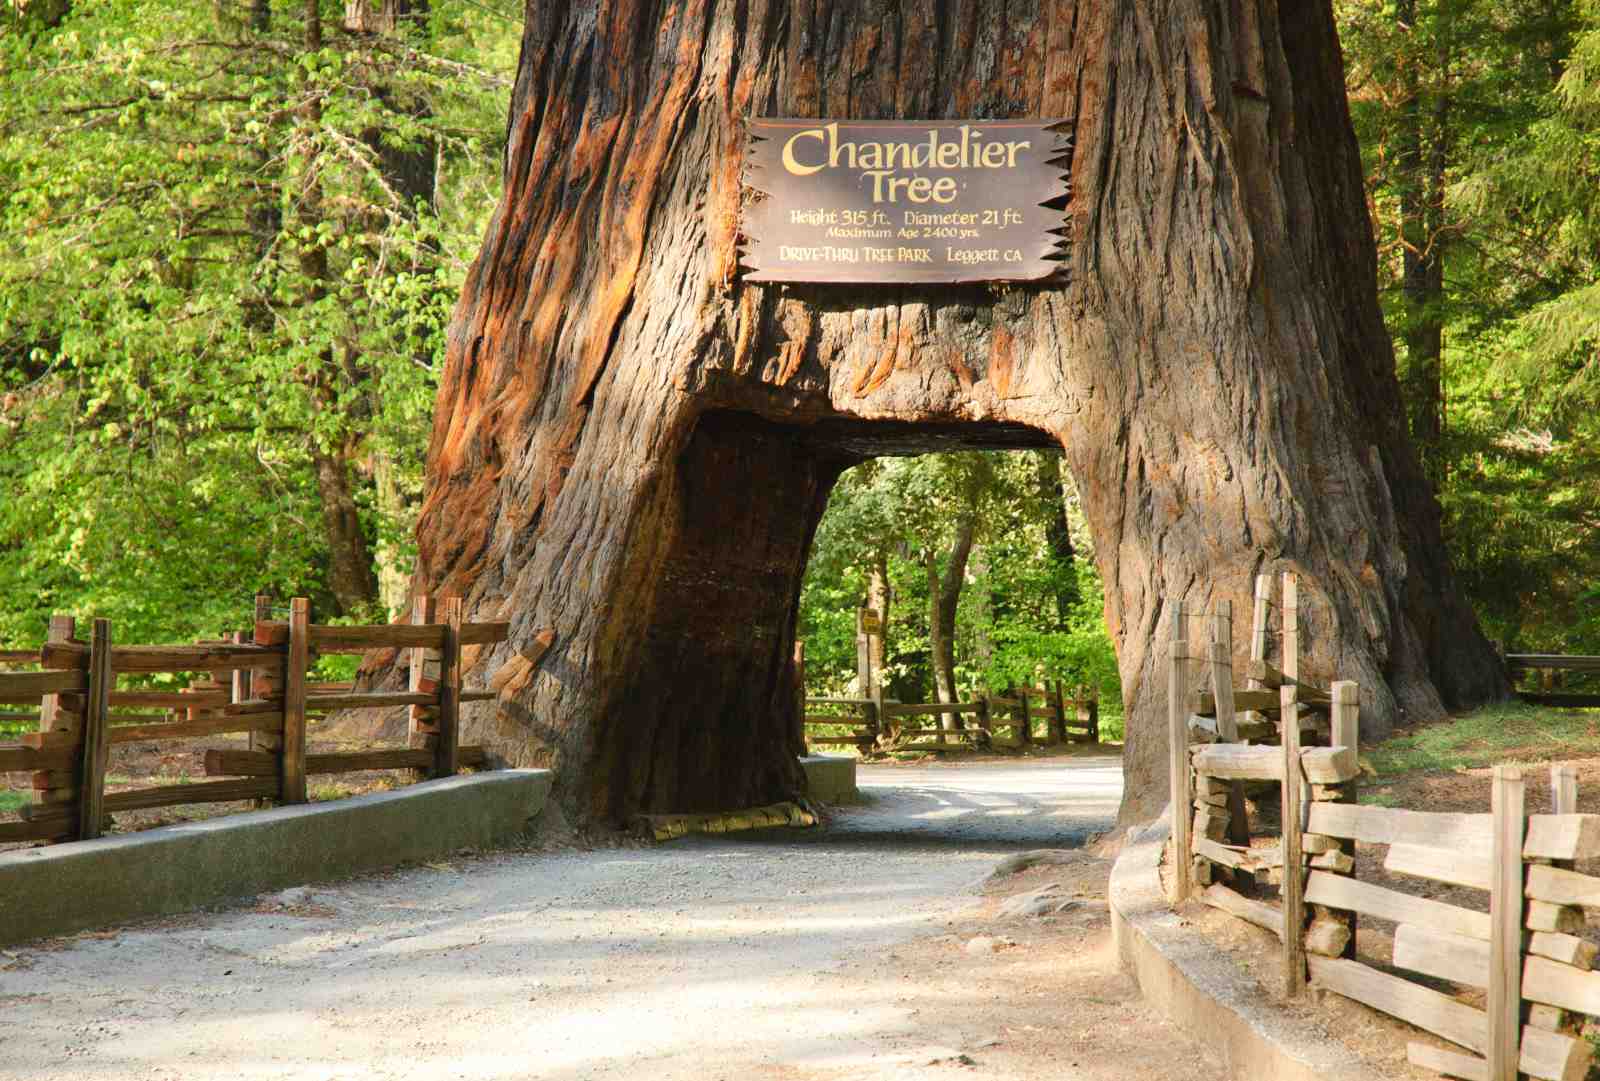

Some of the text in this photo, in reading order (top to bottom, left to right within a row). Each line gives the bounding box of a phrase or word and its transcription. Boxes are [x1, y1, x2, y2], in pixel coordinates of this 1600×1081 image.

[782, 123, 1031, 176] Chandelier
[860, 169, 958, 204] Tree
[790, 209, 1023, 229] Height 315 ft. Diameter 21 ft.
[825, 228, 891, 238] Maximum
[897, 228, 919, 239] Age
[923, 228, 957, 238] 2400
[779, 246, 1022, 264] DRIVE-THRU TREE PARK Leggett CA
